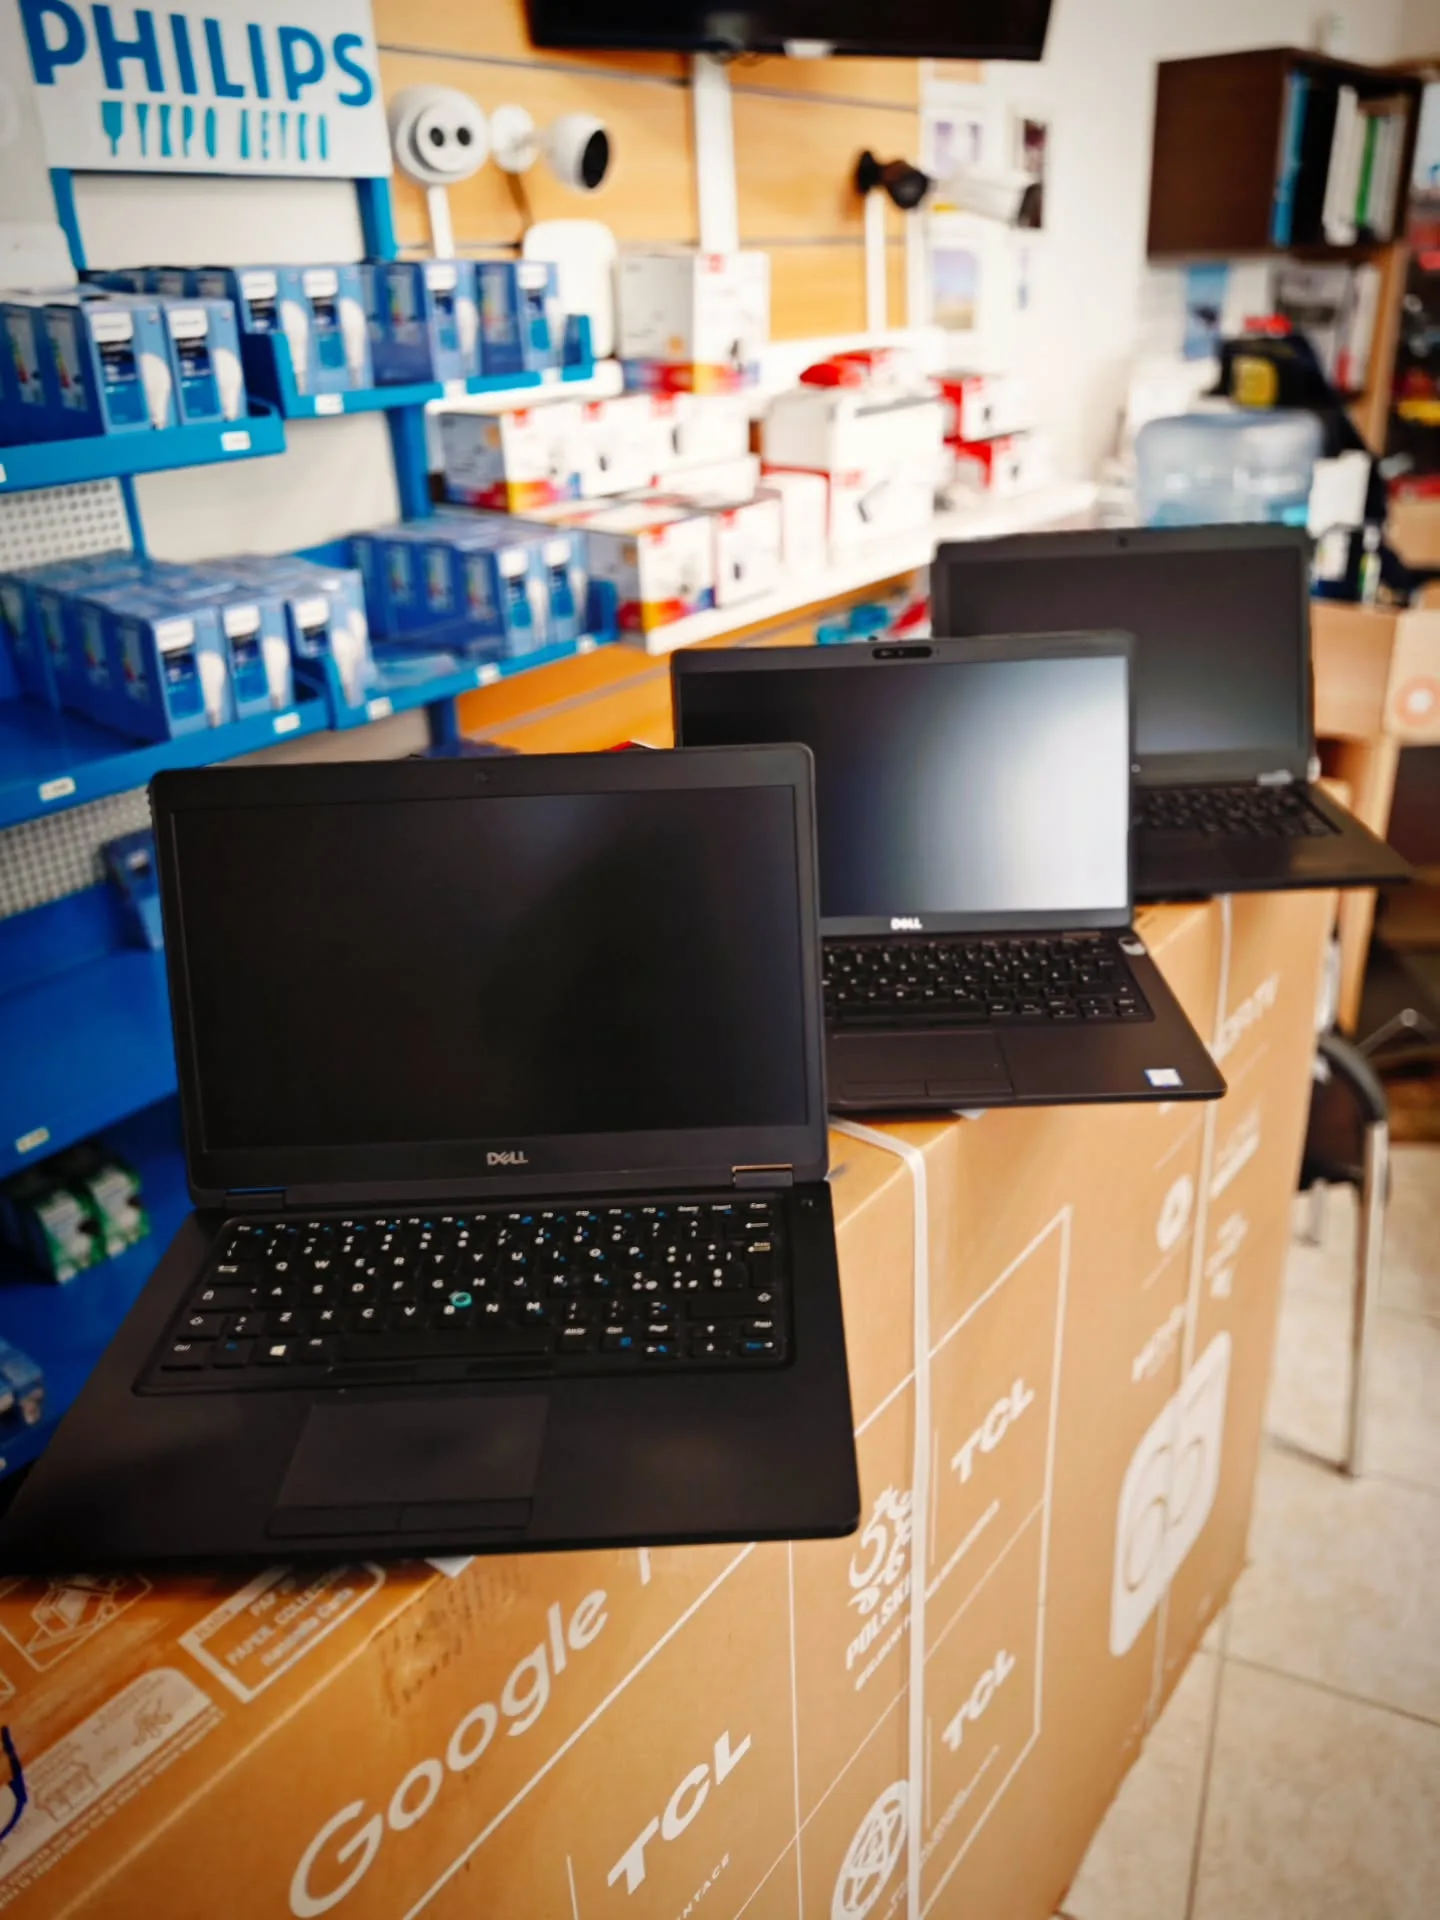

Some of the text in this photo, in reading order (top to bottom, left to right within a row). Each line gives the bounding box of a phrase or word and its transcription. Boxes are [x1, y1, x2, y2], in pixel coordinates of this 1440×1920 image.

[19, 0, 375, 108] PHILIPS
[890, 916, 923, 931] DELL
[486, 1151, 529, 1166] DELL
[951, 1377, 1036, 1483] TCL
[941, 1647, 1016, 1753] TCL
[289, 1589, 609, 1918] Google
[607, 1730, 752, 1896] TCL
